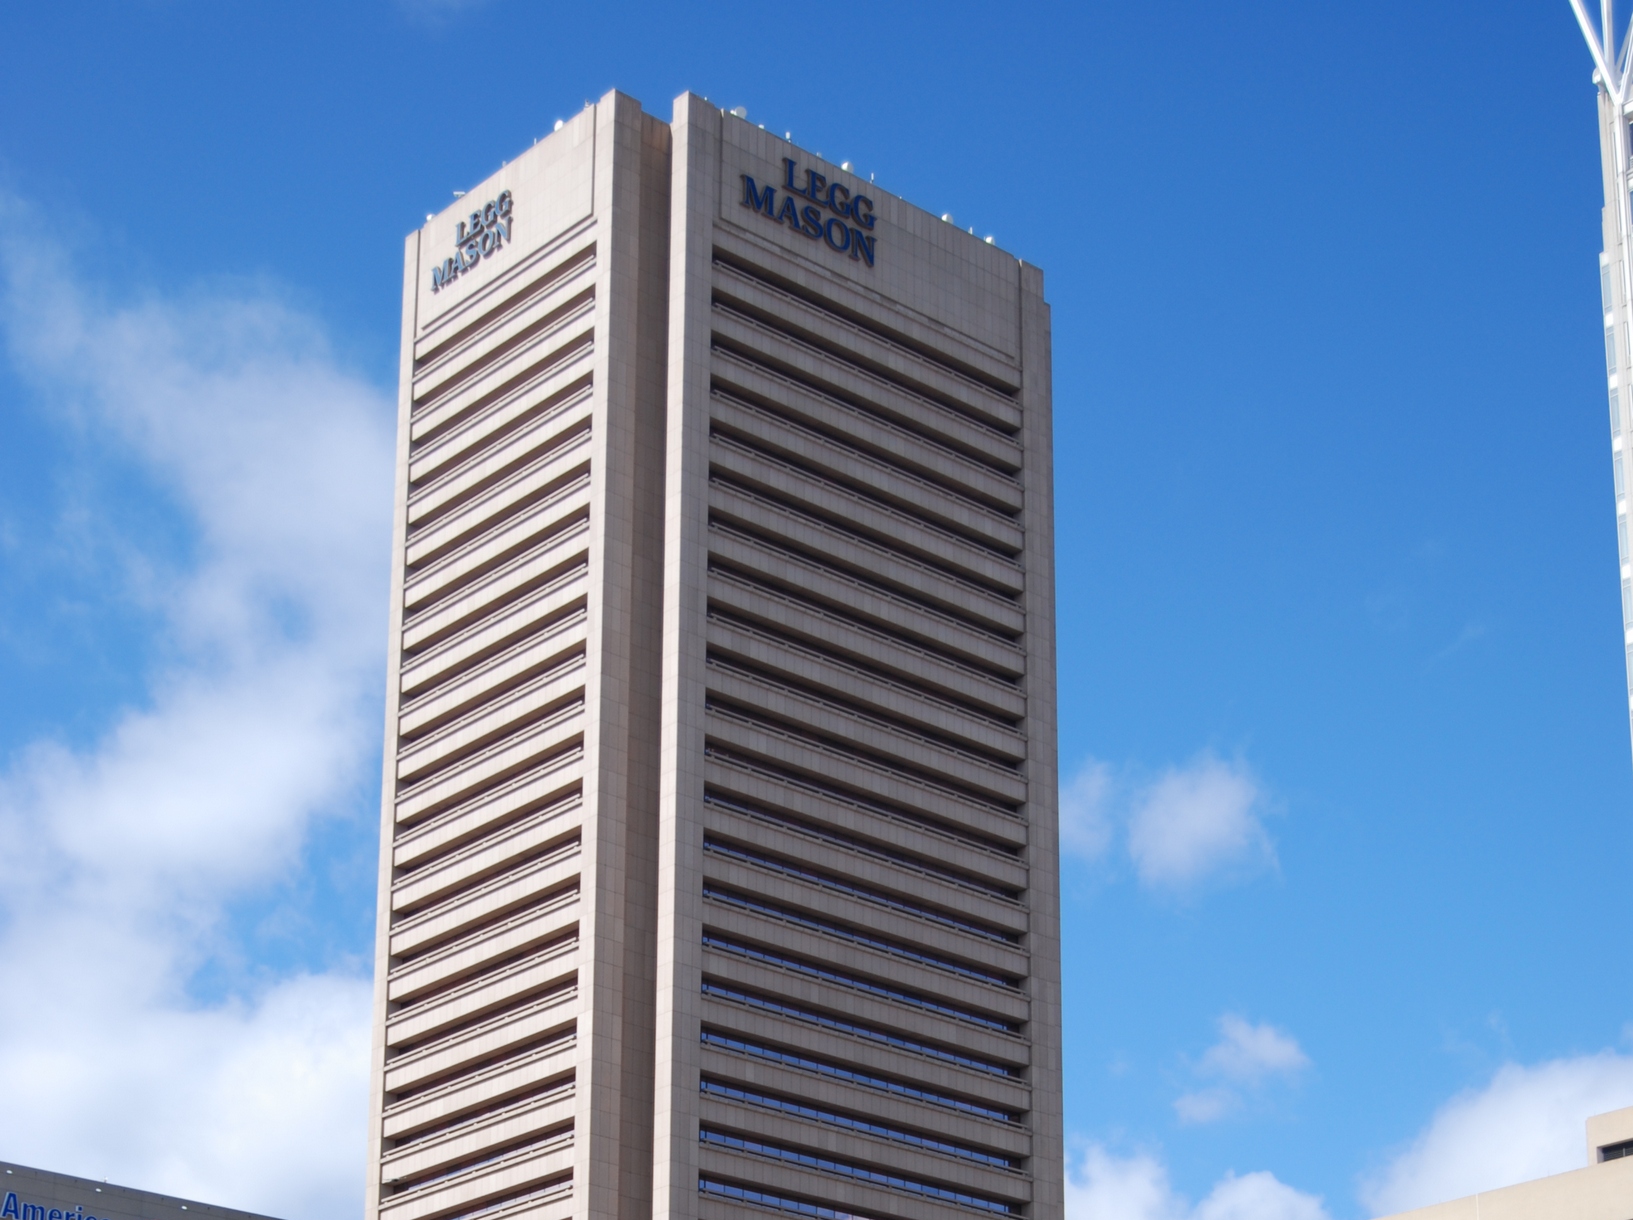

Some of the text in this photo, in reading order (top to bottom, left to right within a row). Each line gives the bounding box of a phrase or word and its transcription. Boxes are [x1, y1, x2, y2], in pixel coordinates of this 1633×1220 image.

[455, 189, 513, 247] LEGG
[740, 174, 877, 268] MASON
[783, 157, 877, 230] LEGG
[431, 216, 513, 294] MASON
